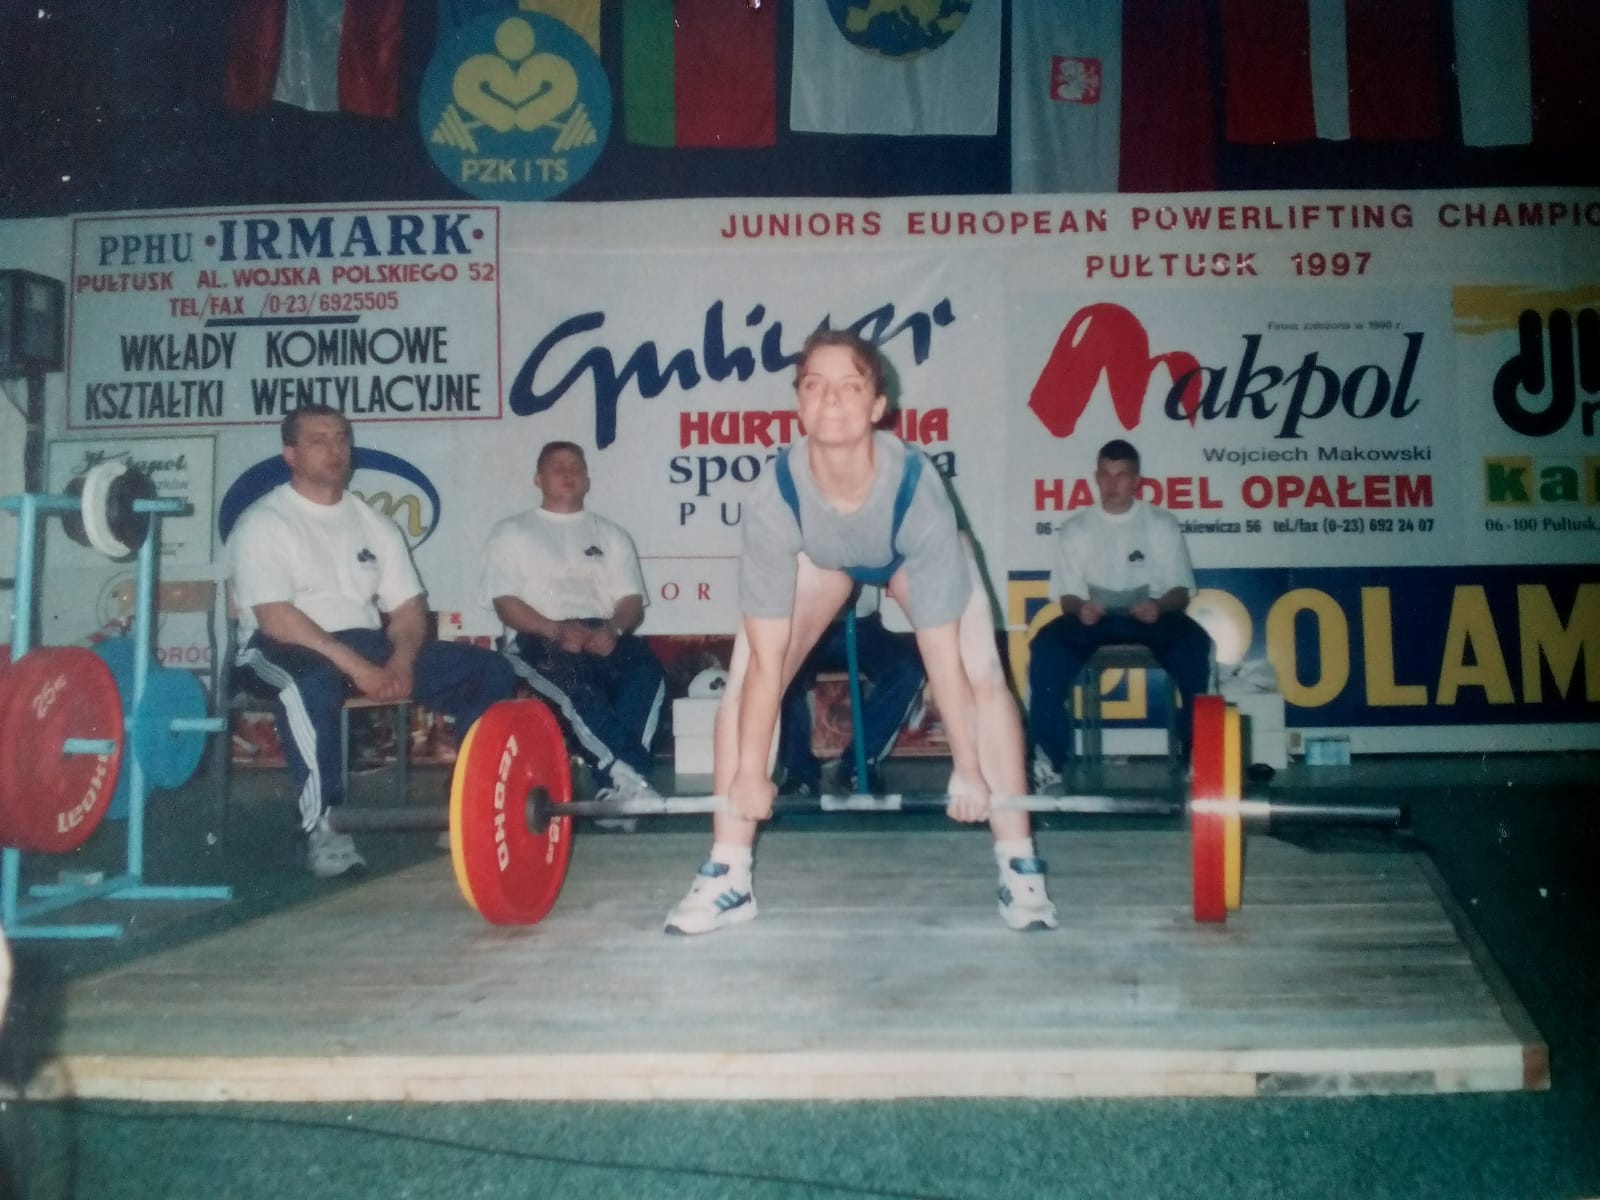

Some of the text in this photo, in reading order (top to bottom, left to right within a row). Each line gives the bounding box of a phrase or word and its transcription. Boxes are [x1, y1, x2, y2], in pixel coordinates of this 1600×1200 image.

[461, 159, 516, 182] PZK
[536, 159, 568, 182] TS
[721, 212, 881, 238] JUNIORS
[908, 209, 1107, 235] EUROPEAN
[1132, 203, 1413, 231] POWERLIFTING
[98, 214, 473, 266] PPHU IRMARK
[77, 263, 495, 293] PUŁTUSK AL. WOJSKA POLSKIEGO 52
[1086, 252, 1372, 279] PUŁTUSK 1997
[169, 294, 244, 318] TEL/FAX
[120, 327, 448, 371] WKŁADY KOMINOWE
[1028, 302, 1425, 439] Makpol
[85, 373, 480, 420] KSZTAŁTKI WENTYLACYJNE
[1203, 445, 1432, 466] Wojciech Makowski
[1034, 474, 1433, 511] HADEL OPAŁEM
[1246, 519, 1262, 533] 56
[1369, 518, 1394, 533] 692
[1398, 518, 1415, 532] 24
[1418, 518, 1434, 532] 07
